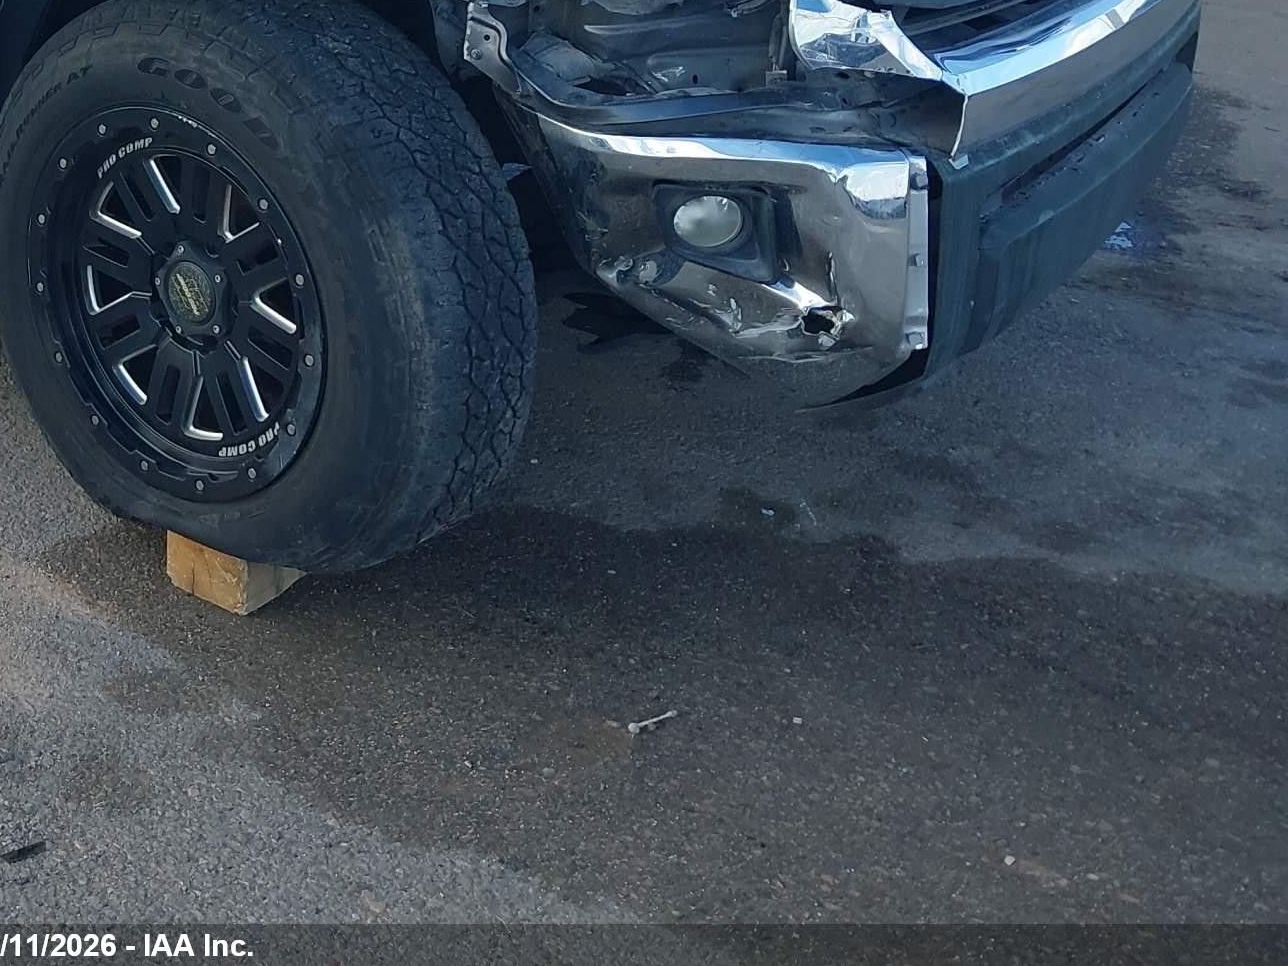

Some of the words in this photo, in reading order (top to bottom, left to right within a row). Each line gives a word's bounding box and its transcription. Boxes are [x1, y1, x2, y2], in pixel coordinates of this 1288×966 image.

[97, 154, 117, 179] PRO
[118, 137, 153, 158] COMP
[218, 440, 256, 457] COMP
